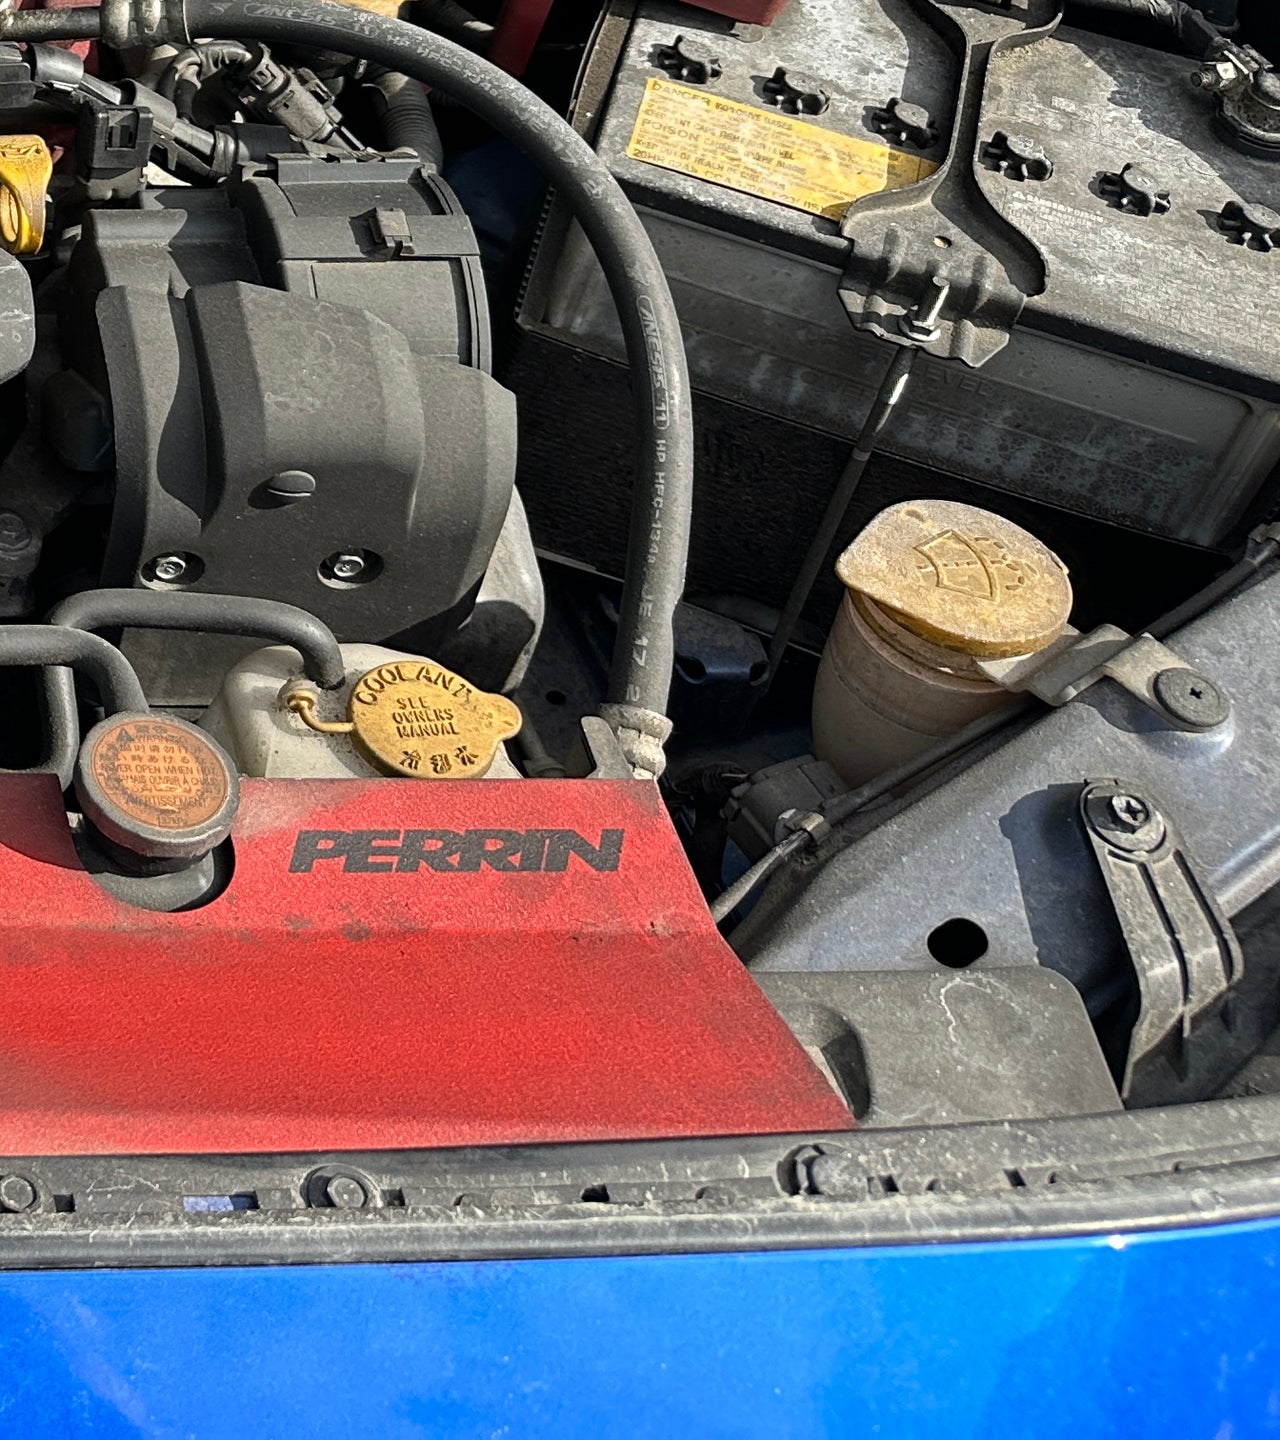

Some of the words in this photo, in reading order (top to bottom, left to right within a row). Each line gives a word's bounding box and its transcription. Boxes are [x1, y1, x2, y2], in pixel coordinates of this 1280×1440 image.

[651, 79, 711, 106] DANGER
[641, 118, 701, 142] POISON
[655, 439, 667, 463] HP
[355, 664, 473, 706] COOLANT
[396, 696, 430, 711] SEE
[396, 720, 460, 740] MANUAL
[135, 763, 161, 774] OPEN
[288, 829, 626, 873] PERRIN
